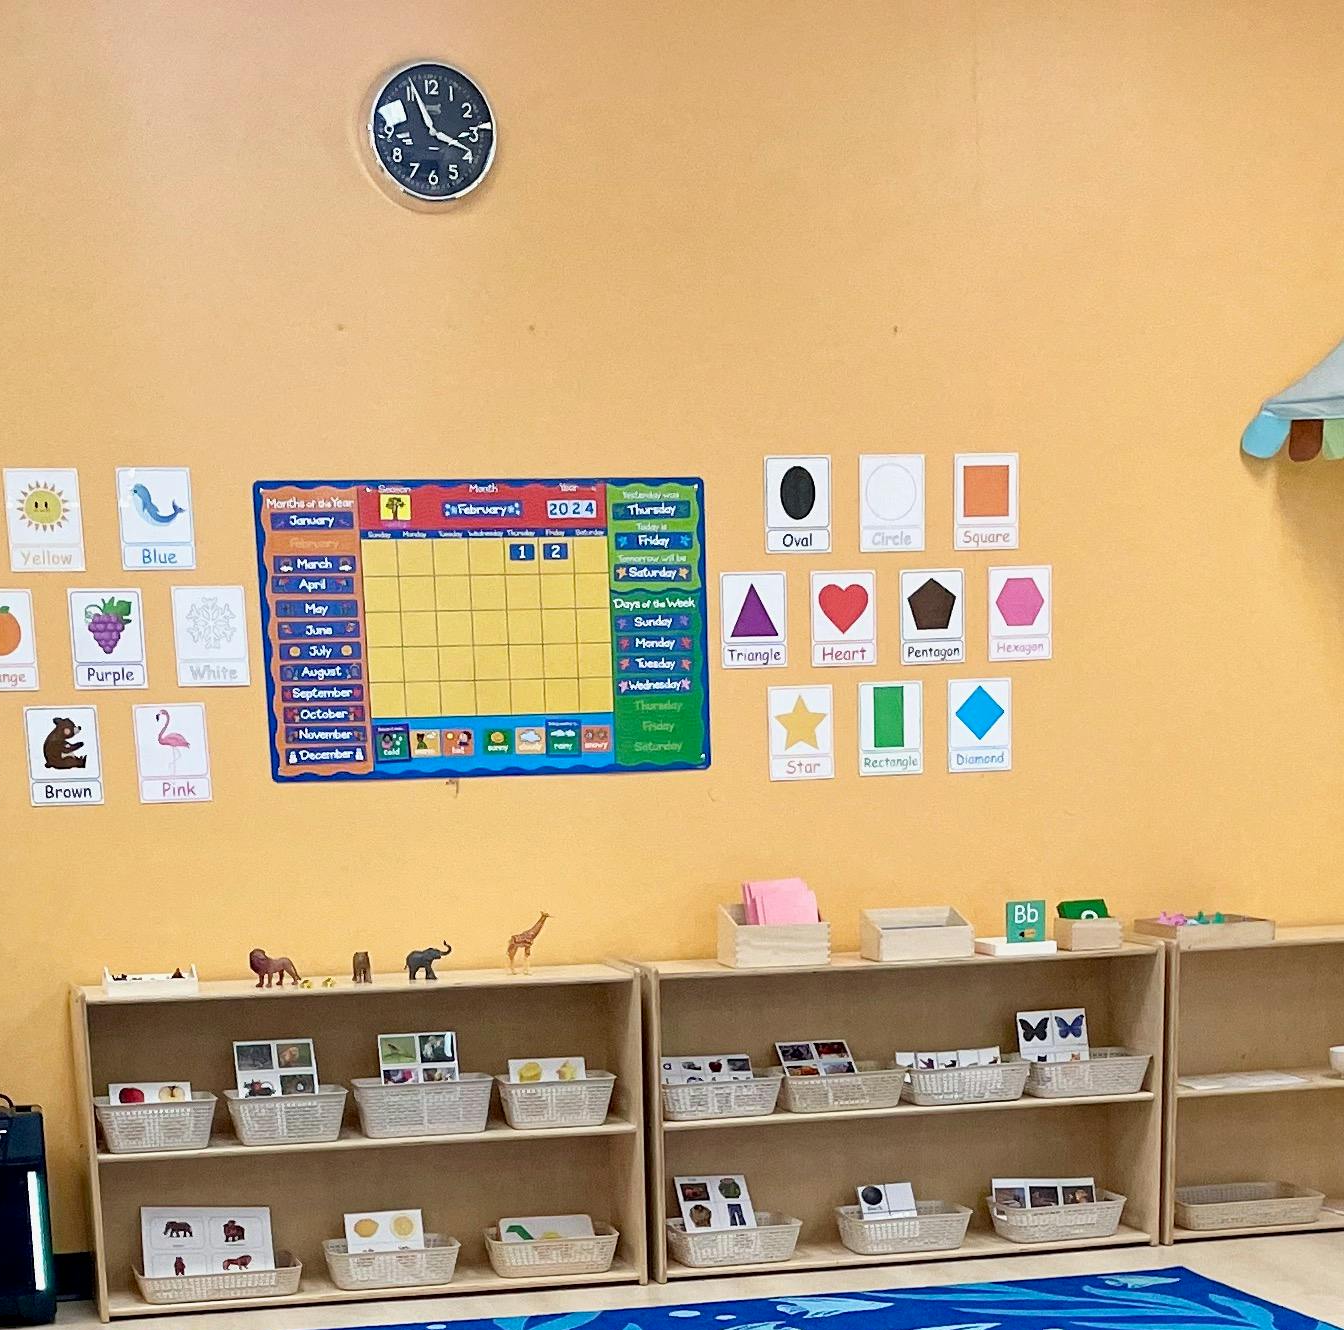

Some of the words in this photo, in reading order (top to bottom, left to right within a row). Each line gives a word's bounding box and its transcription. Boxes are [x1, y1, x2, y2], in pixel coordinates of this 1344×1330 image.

[425, 80, 439, 95] 12
[449, 85, 454, 102] 1
[462, 103, 472, 118] 2
[384, 124, 394, 142] 9
[469, 126, 479, 142] 3
[392, 148, 402, 162] 8
[462, 151, 472, 164] 4
[410, 163, 420, 178] 7
[428, 170, 438, 185] 6
[448, 164, 458, 180] 5
[468, 483, 498, 493] Month
[559, 482, 578, 492] Year
[266, 497, 305, 509] Months
[306, 500, 316, 508] of
[318, 500, 332, 508] the
[330, 497, 354, 508] Year
[458, 503, 507, 516] February
[549, 502, 594, 516] 2024
[628, 503, 676, 516] Thursday
[289, 515, 334, 528] January
[638, 534, 670, 548] Friday
[782, 533, 813, 548] Oval
[871, 532, 912, 546] Circle
[963, 530, 1010, 546] Square
[20, 551, 72, 566] Yellow
[142, 549, 178, 564] Blue
[518, 546, 526, 559] 1
[552, 546, 560, 559] 2
[296, 557, 332, 570] March
[628, 566, 678, 580] Saturday
[298, 578, 326, 592] April
[304, 602, 328, 616] May
[614, 598, 640, 612] Days
[642, 600, 651, 608] of
[653, 599, 666, 608] the
[666, 597, 696, 608] Week
[634, 615, 672, 628] Sunday
[306, 624, 332, 636] June
[635, 637, 676, 650] Monday
[996, 642, 1044, 655] Hexagon
[308, 645, 332, 659] July
[728, 649, 782, 666] Triangle
[822, 648, 866, 661] Heart
[908, 646, 960, 662] Pentagon
[635, 658, 676, 670] Tuesday
[87, 667, 134, 686] Purple
[190, 664, 238, 681] White
[300, 666, 342, 680] August
[629, 678, 682, 690] Wednesday
[292, 687, 353, 702] September
[634, 700, 684, 712] Thursday
[300, 708, 348, 720] October
[642, 721, 676, 732] Friday
[299, 728, 353, 740] November
[384, 747, 400, 756] cold
[634, 741, 684, 753] Saturday
[299, 749, 354, 760] December
[956, 752, 1005, 765] Diamond
[786, 761, 821, 775] Star
[864, 756, 918, 770] Rectangle
[44, 784, 92, 800] Brown
[162, 782, 196, 796] Pink
[1014, 903, 1038, 924] Bb
